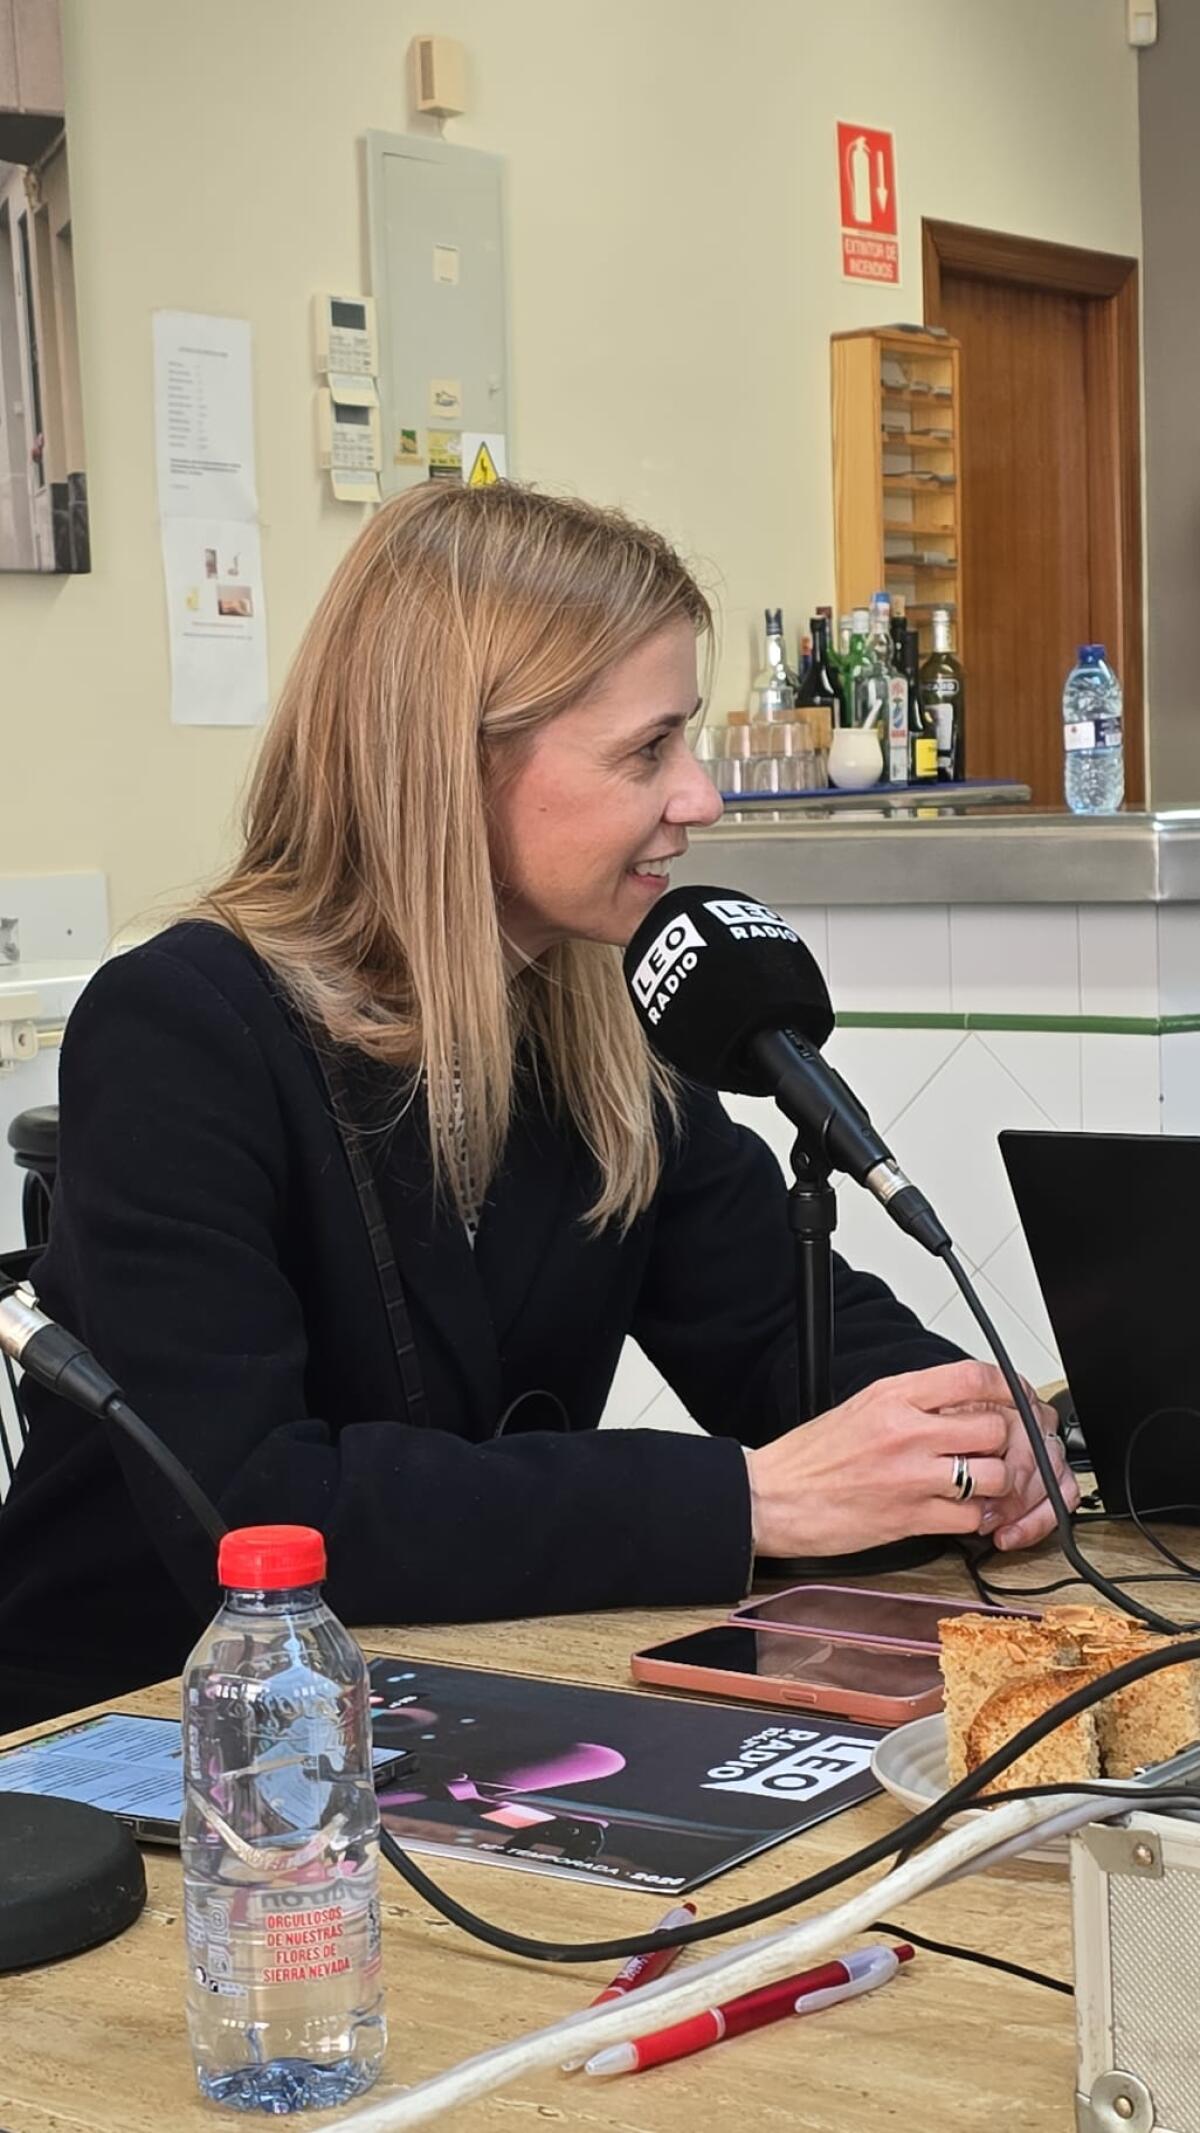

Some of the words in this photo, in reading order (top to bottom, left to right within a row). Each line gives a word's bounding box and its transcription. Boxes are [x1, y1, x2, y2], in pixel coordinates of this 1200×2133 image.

[844, 237, 884, 257] EXTINTOR
[885, 243, 898, 260] DE
[849, 257, 894, 279] INCENDIOS
[729, 925, 799, 943] RADIO
[636, 925, 687, 997] LEO
[648, 951, 698, 1026] RADIO
[706, 1728, 822, 1779] RADIO
[761, 1741, 877, 1792] LEO
[507, 1847, 620, 1876] TEMPORADA
[266, 1906, 343, 1930] ORGULLOSOS
[266, 1932, 283, 1948] DE
[285, 1925, 344, 1947] NUESTRAS
[276, 1948, 320, 1965] FLORES
[323, 1943, 337, 1957] DE
[263, 1966, 306, 1983] SIERRA
[308, 1957, 351, 1978] NEVADA
